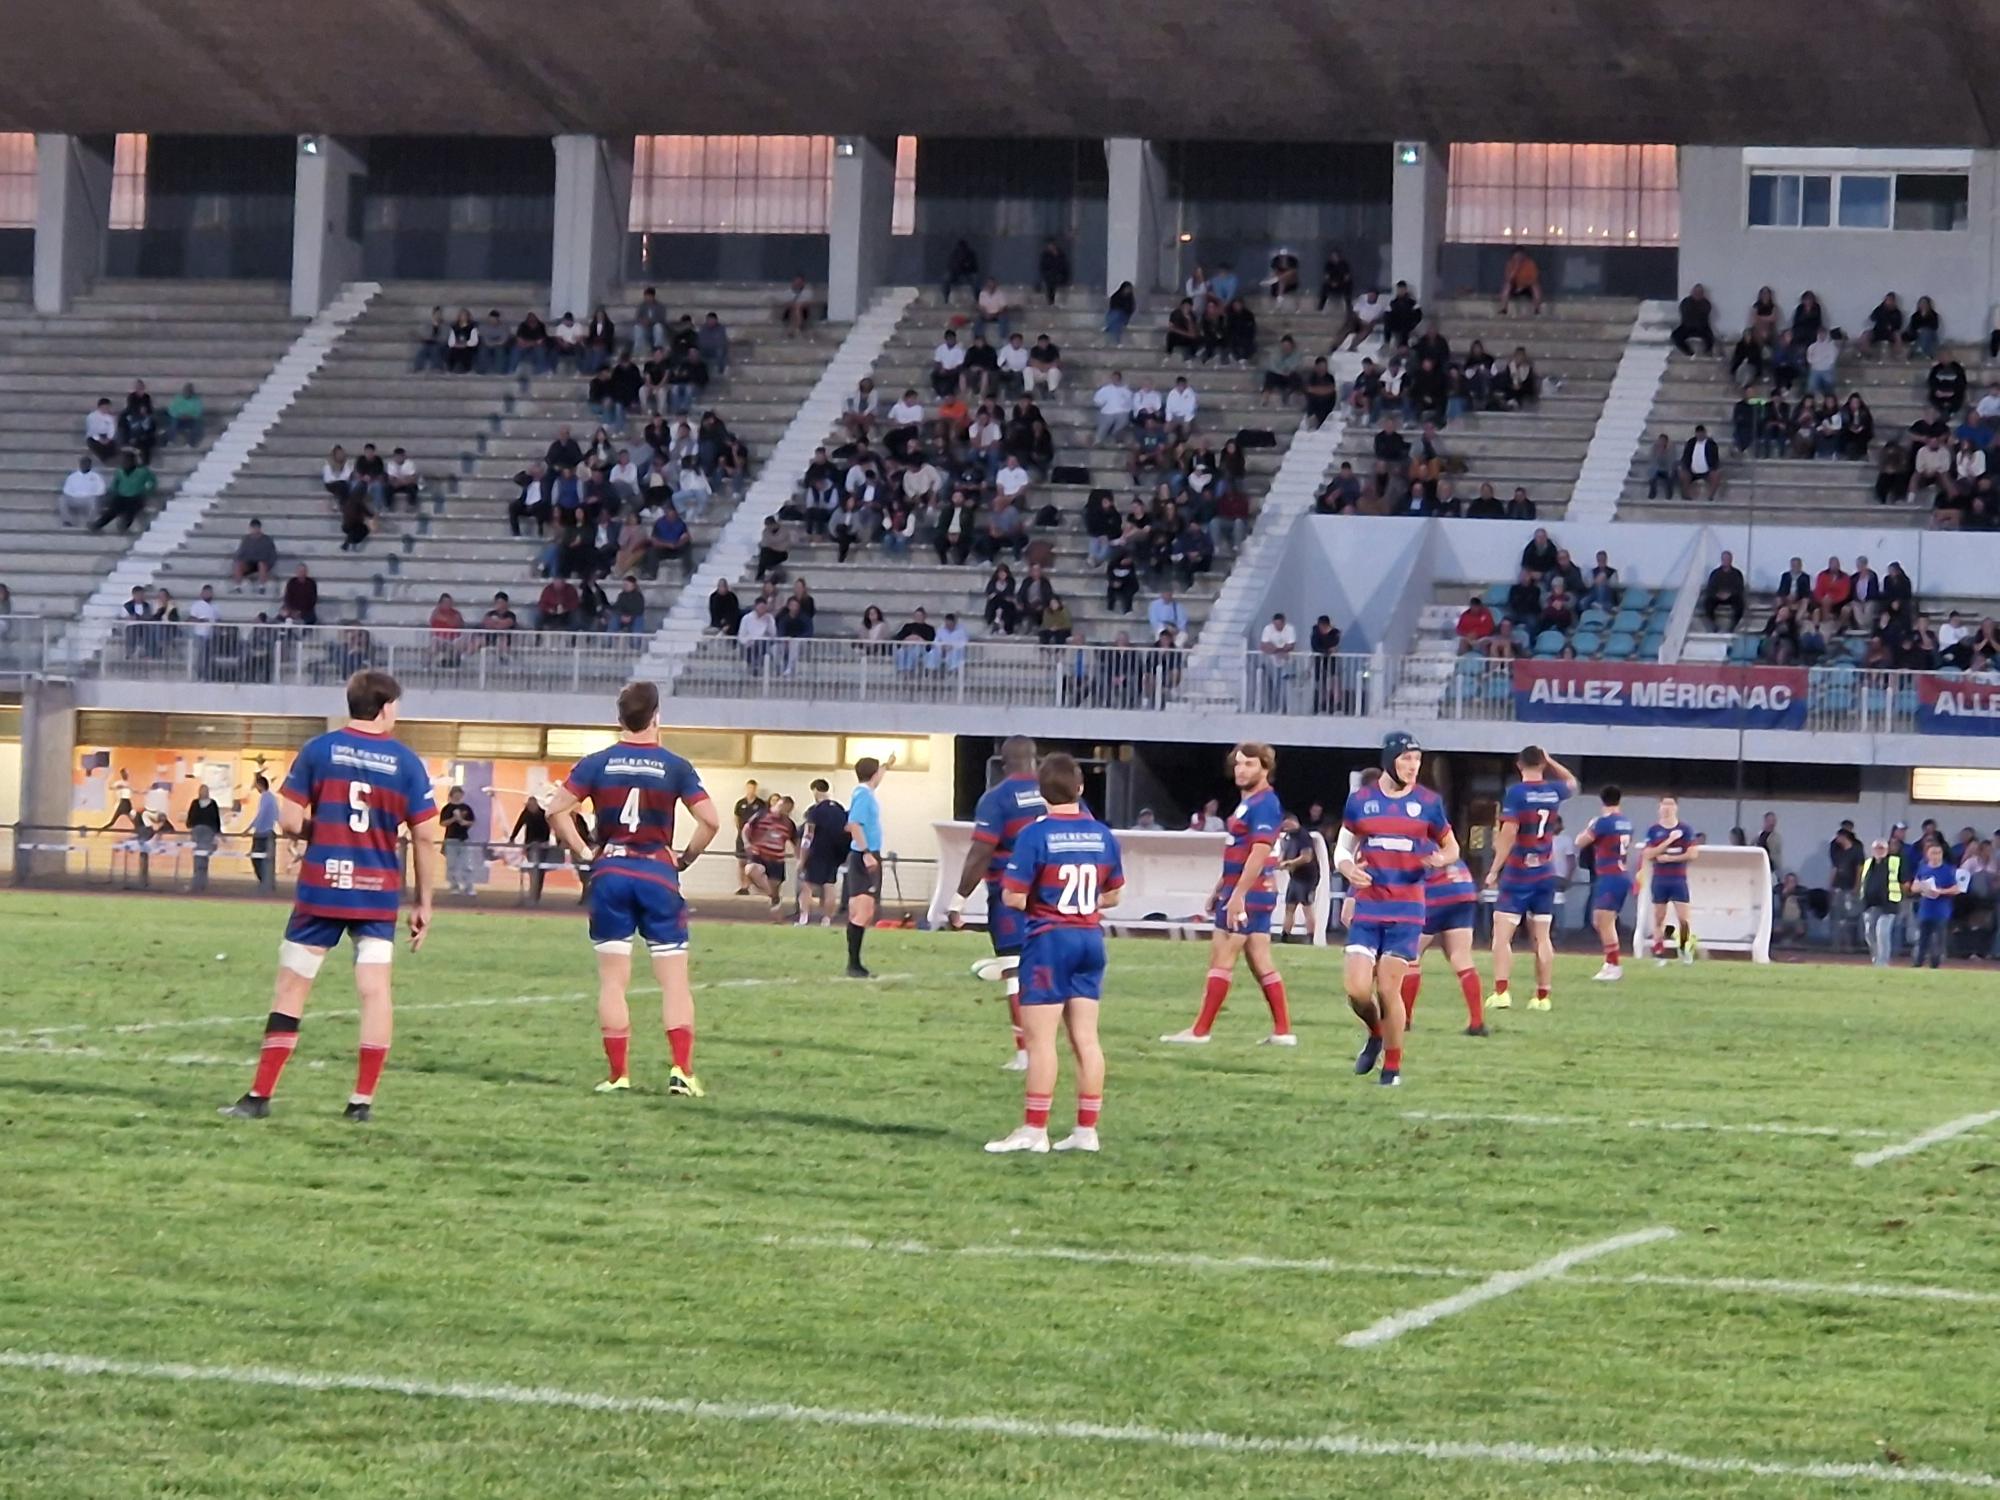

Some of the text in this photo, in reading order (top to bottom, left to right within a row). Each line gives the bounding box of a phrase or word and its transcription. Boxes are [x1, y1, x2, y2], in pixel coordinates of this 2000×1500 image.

[1529, 677, 1792, 710] ALLEZ MÉRIGNAC
[348, 781, 372, 833] 5
[619, 787, 640, 833] 4
[1537, 809, 1550, 839] 7
[1057, 864, 1097, 915] 20
